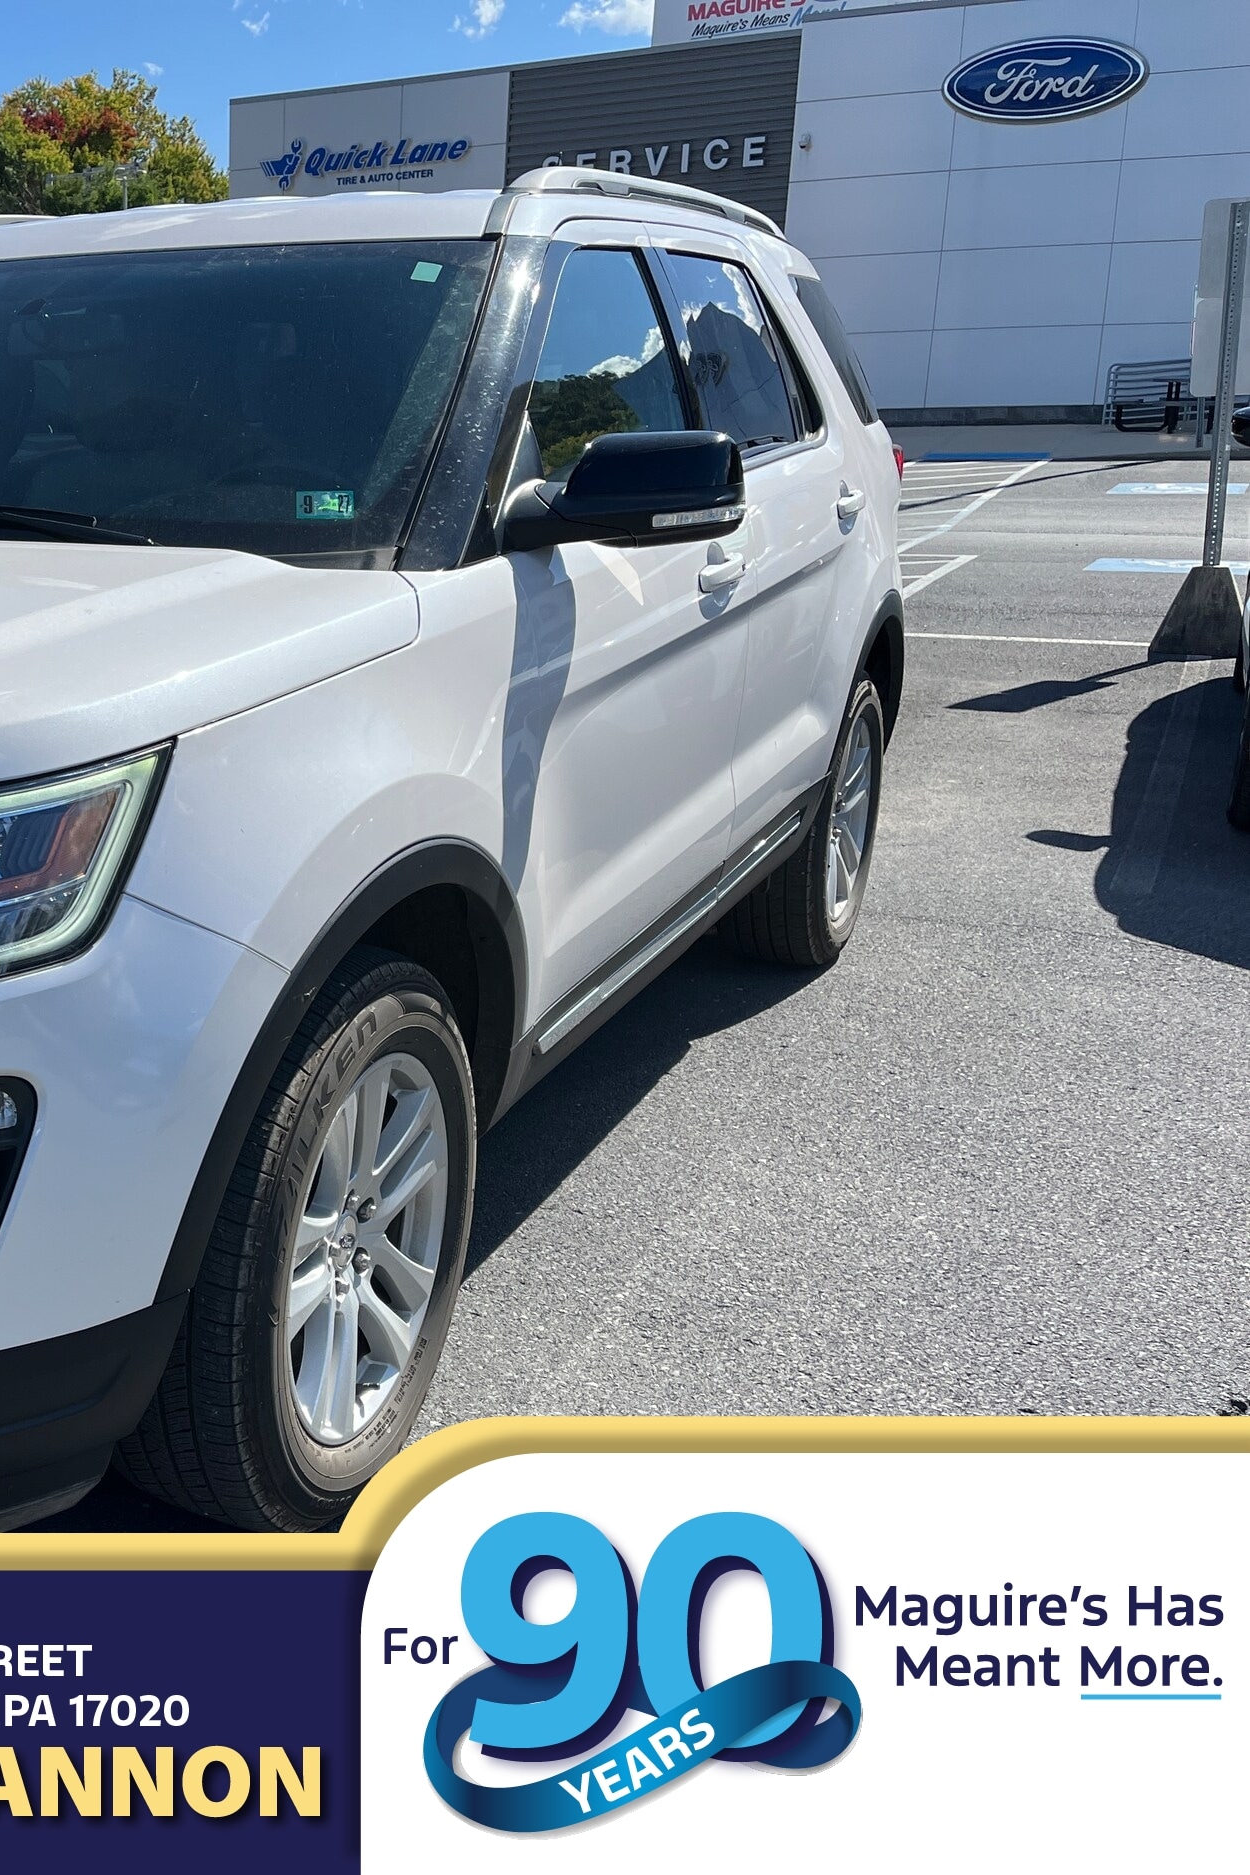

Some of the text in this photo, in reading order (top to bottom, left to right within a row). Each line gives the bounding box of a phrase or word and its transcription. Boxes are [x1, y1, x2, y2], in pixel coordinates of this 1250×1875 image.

[688, 0, 806, 21] MAGUIRE
[691, 18, 748, 39] Maguire's
[750, 13, 790, 28] Means
[984, 56, 1099, 105] Ford
[304, 139, 468, 176] Quick Lane
[336, 169, 434, 186] TIRE & AUTO CENTER
